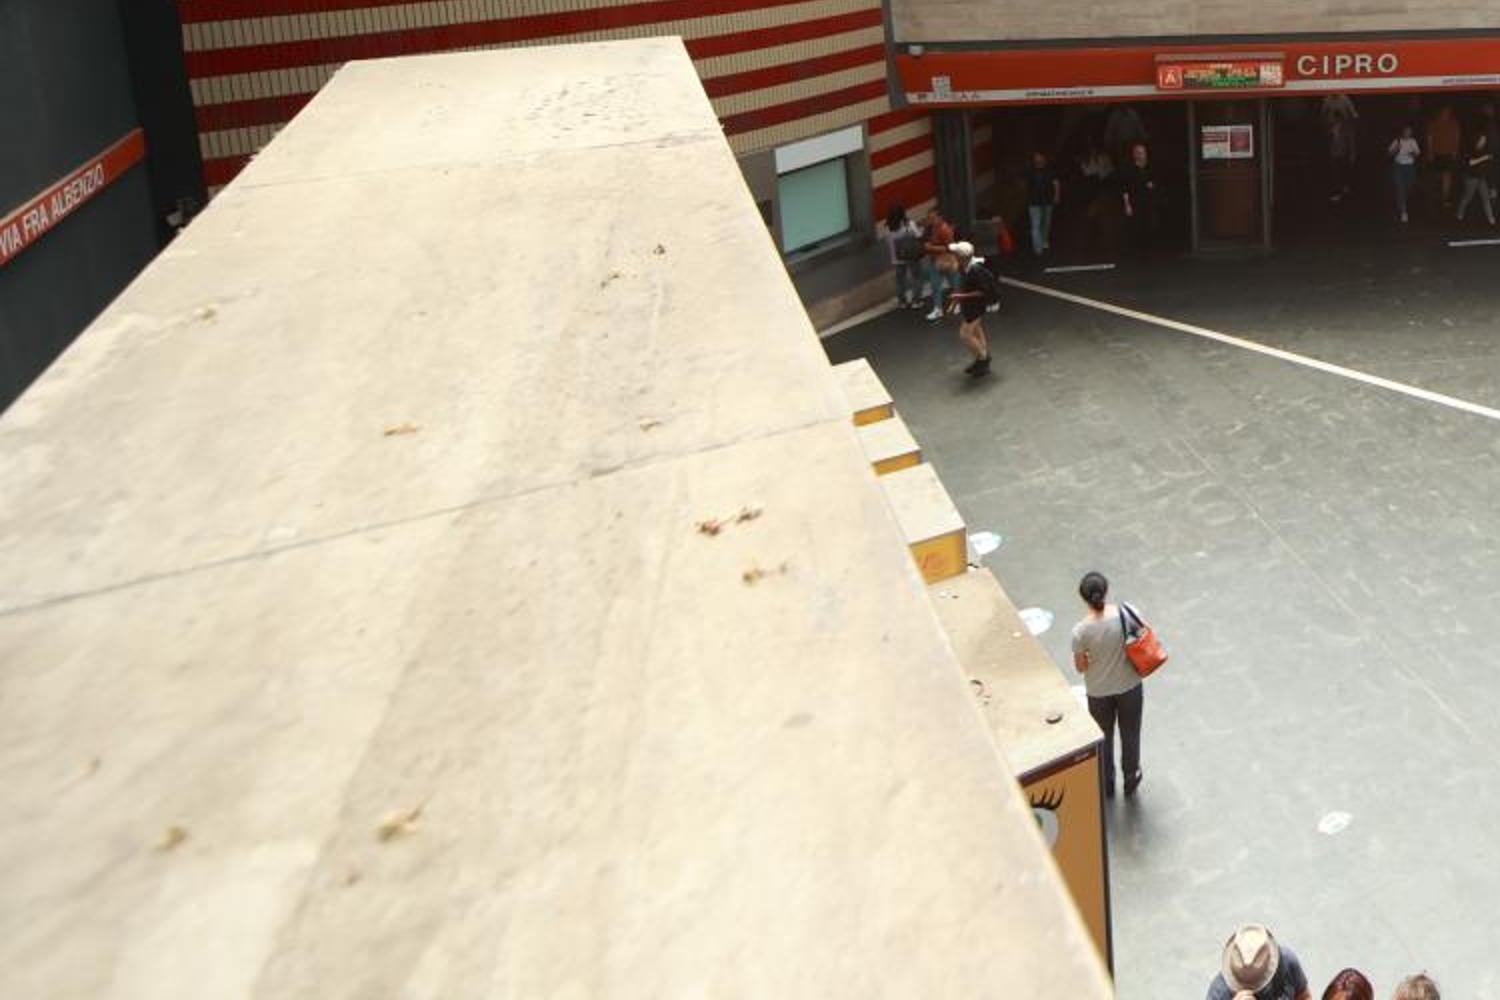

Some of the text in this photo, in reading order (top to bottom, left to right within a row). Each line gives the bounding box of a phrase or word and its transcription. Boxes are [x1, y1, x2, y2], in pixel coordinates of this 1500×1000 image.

[1297, 53, 1399, 75] CIPRO
[0, 163, 104, 256] VIA FRA ALBENZIO
